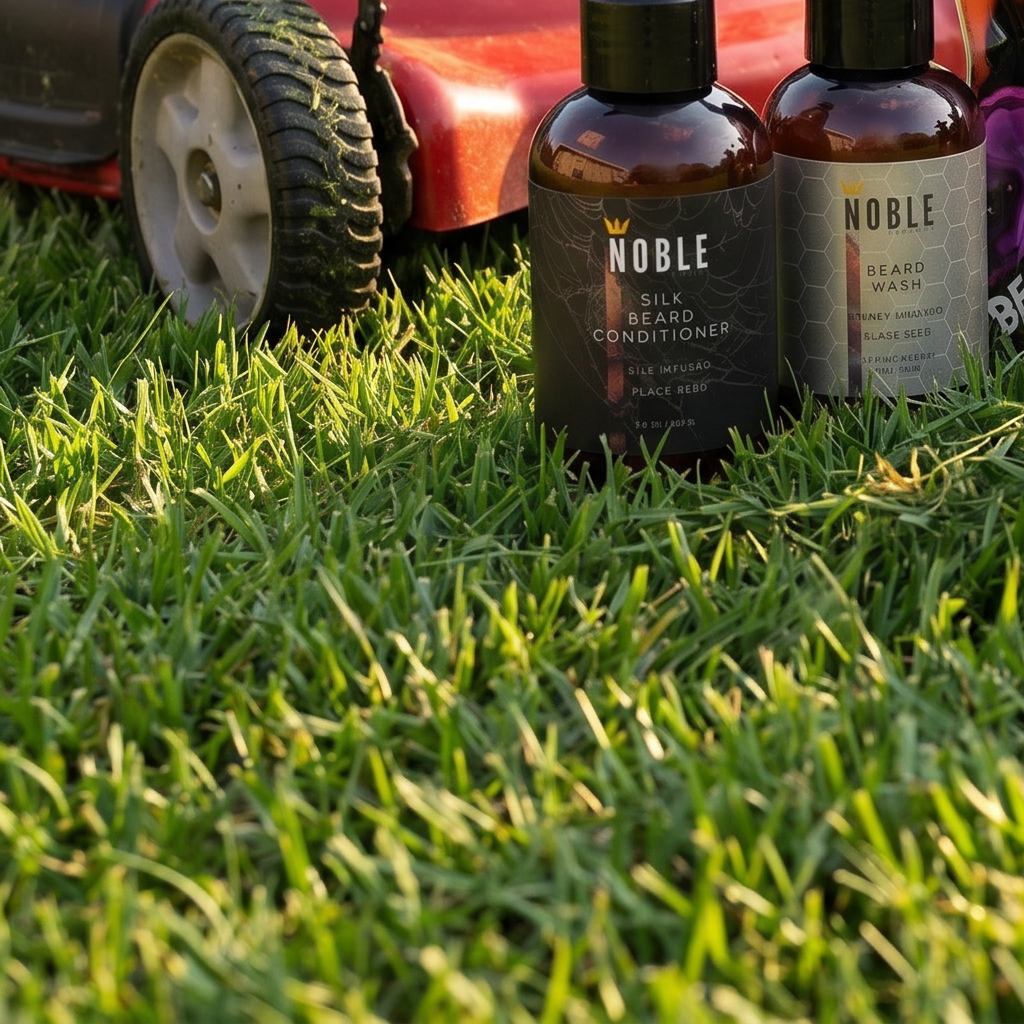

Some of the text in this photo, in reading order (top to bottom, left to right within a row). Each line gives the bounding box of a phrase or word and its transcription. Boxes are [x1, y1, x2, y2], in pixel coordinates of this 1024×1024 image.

[844, 193, 935, 231] NOBLE
[608, 233, 709, 274] NOBLE
[867, 261, 925, 276] BEARD
[871, 278, 922, 293] WASH
[640, 291, 683, 307] SILK
[628, 309, 694, 326] BEARD
[593, 321, 729, 344] CONDITIONER
